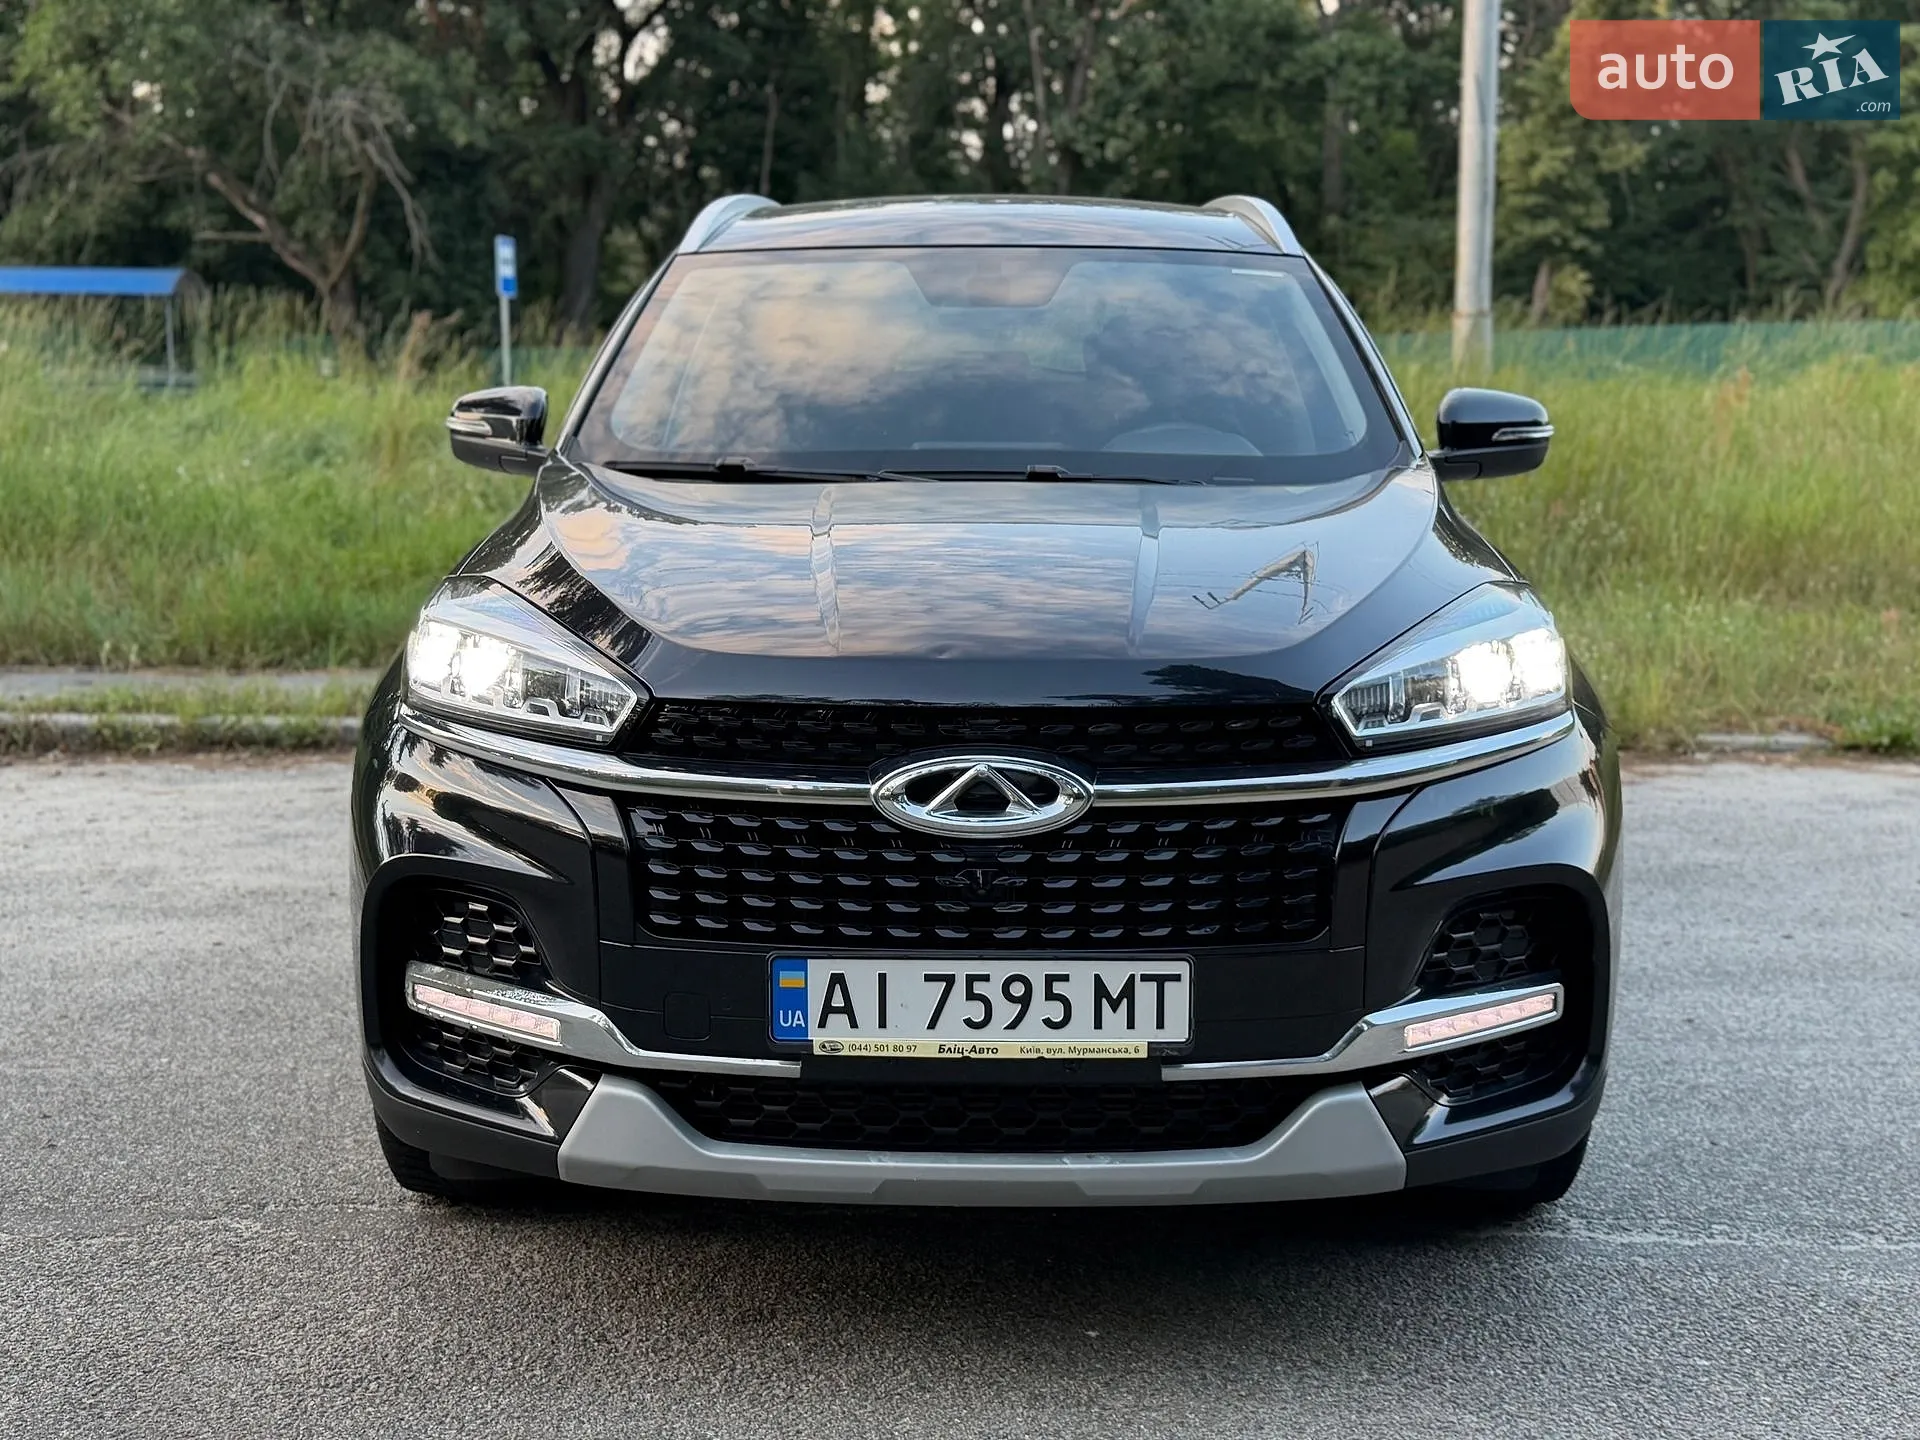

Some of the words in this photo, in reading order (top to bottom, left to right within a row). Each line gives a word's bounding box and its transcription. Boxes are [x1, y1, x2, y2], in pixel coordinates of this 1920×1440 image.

[817, 972, 887, 1029] AI
[922, 973, 1073, 1030] 7595
[1093, 973, 1182, 1030] MT
[779, 1010, 806, 1027] UA
[848, 1043, 872, 1053] (044)
[874, 1043, 891, 1052] 501
[892, 1043, 905, 1052] 80
[906, 1043, 917, 1052] 97
[938, 1044, 999, 1056] Бліц-Авто
[1046, 1047, 1066, 1055] вул.
[1068, 1046, 1132, 1055] Мурманська,
[1133, 1046, 1140, 1054] 6
